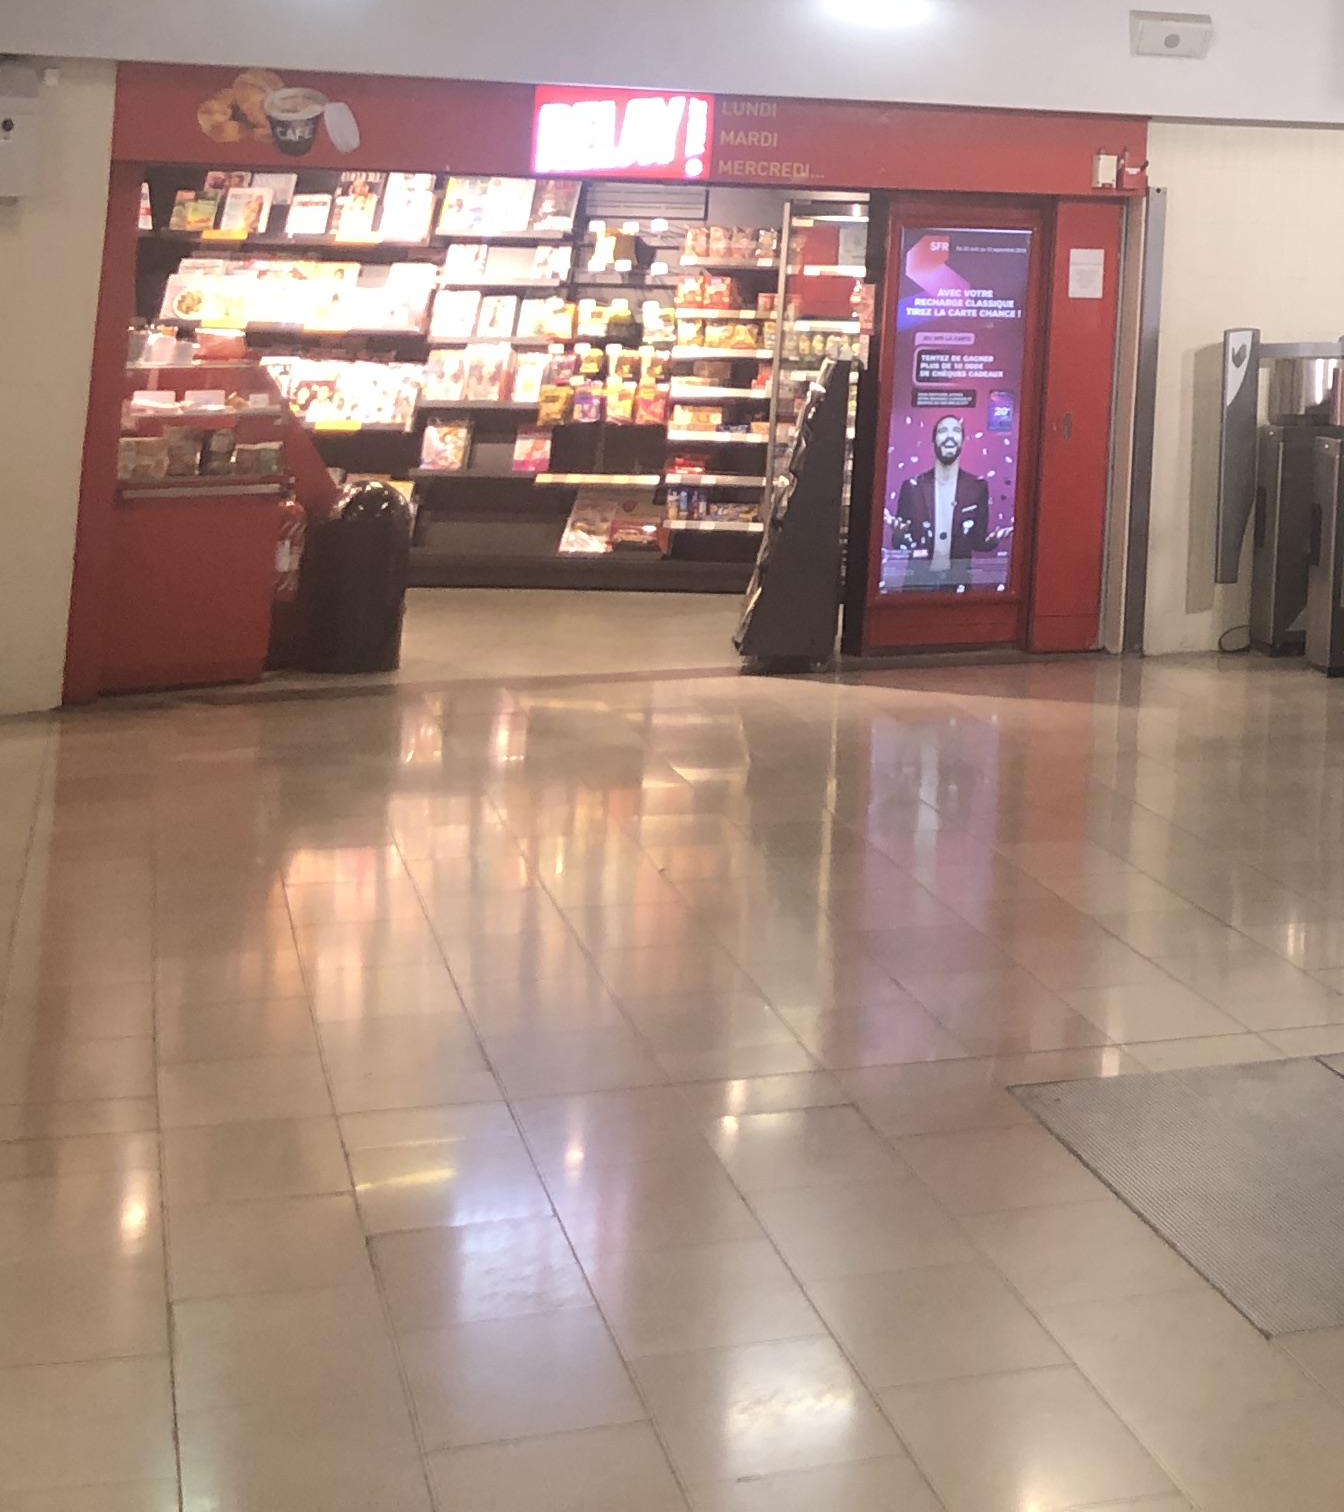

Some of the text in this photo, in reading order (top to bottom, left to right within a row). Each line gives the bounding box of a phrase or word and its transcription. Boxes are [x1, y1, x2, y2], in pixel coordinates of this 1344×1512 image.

[721, 101, 778, 118] LUNDI
[719, 130, 778, 148] MARDI
[718, 159, 825, 180] MERCREDI...
[930, 242, 949, 252] SFR
[937, 289, 993, 298] AVEC VOTRE
[914, 298, 1014, 309] RECHARGE CLASSIQUE
[906, 307, 932, 316] TIREZ
[934, 308, 945, 317] LA
[948, 308, 977, 317] CARTE
[979, 309, 1016, 318] CHANCE
